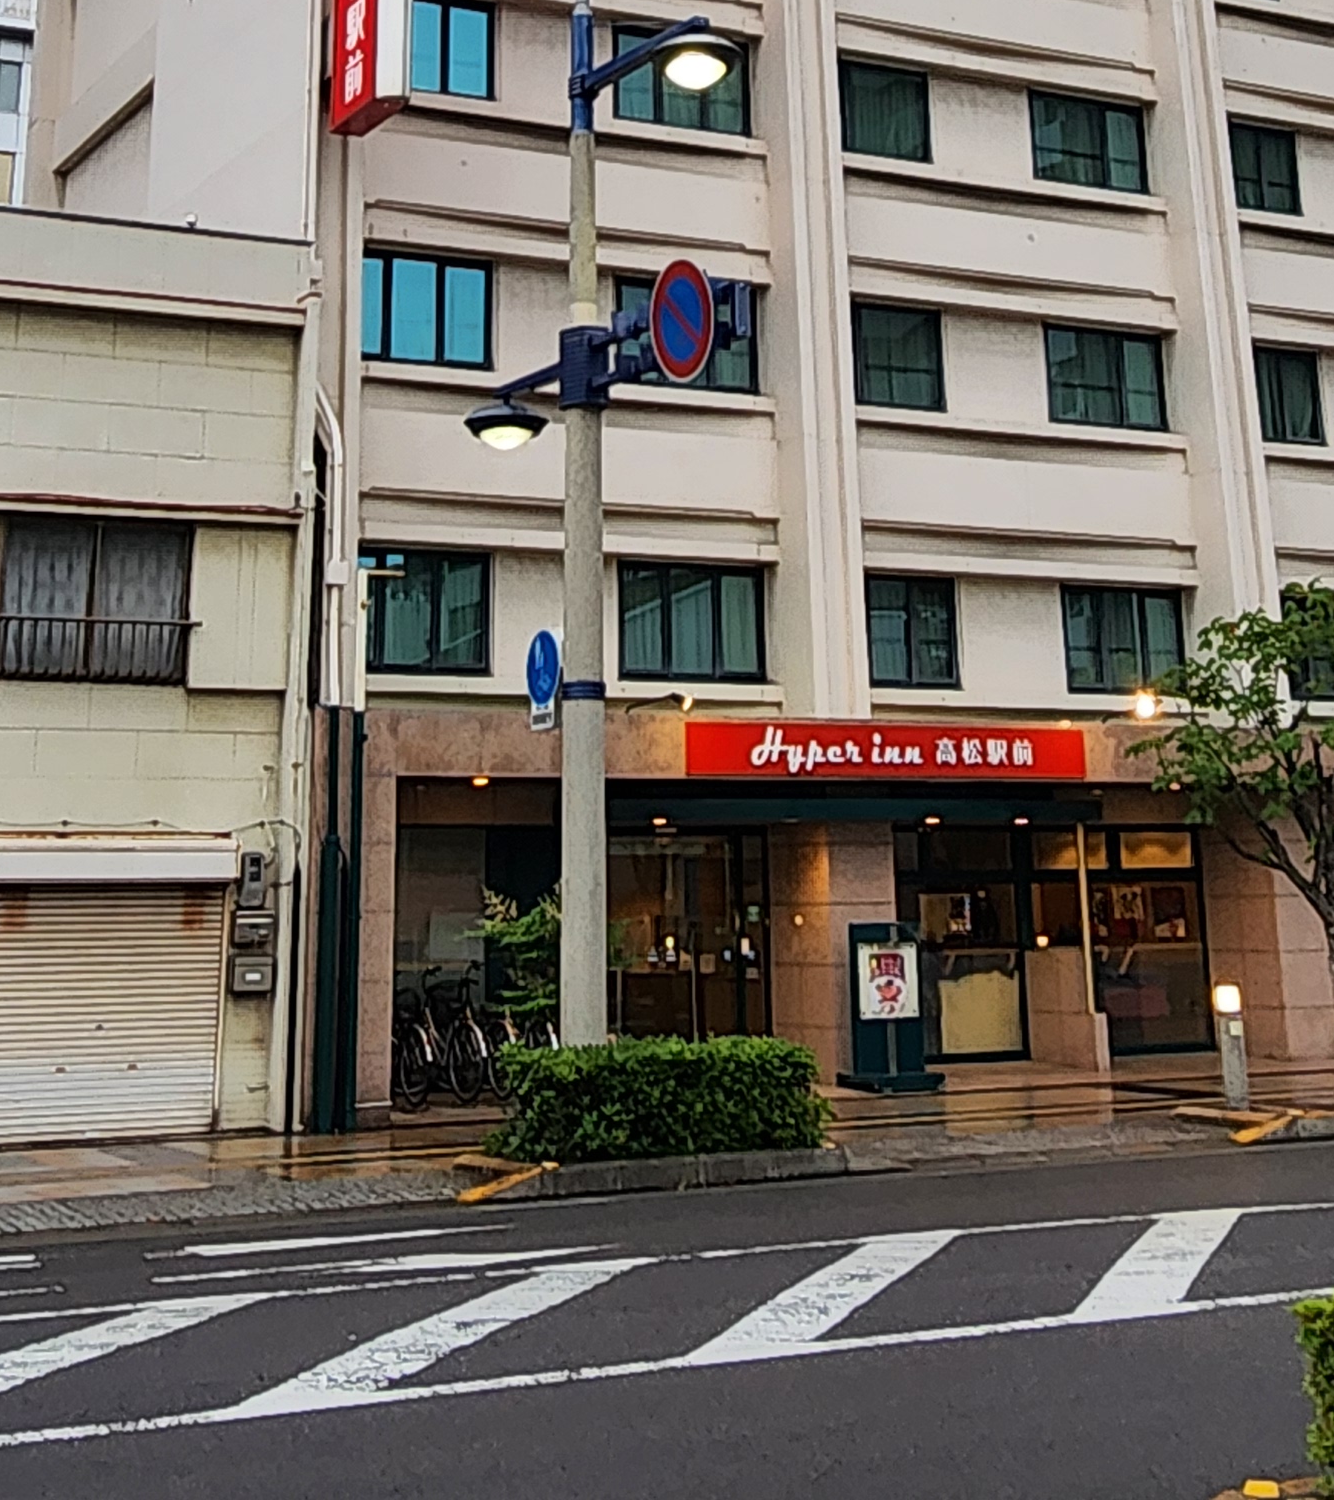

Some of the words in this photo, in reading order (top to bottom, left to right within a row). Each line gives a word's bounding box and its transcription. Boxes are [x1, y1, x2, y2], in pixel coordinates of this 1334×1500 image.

[751, 726, 863, 774] Hyper
[872, 732, 924, 765] inn
[935, 738, 1034, 767] 高松駅前
